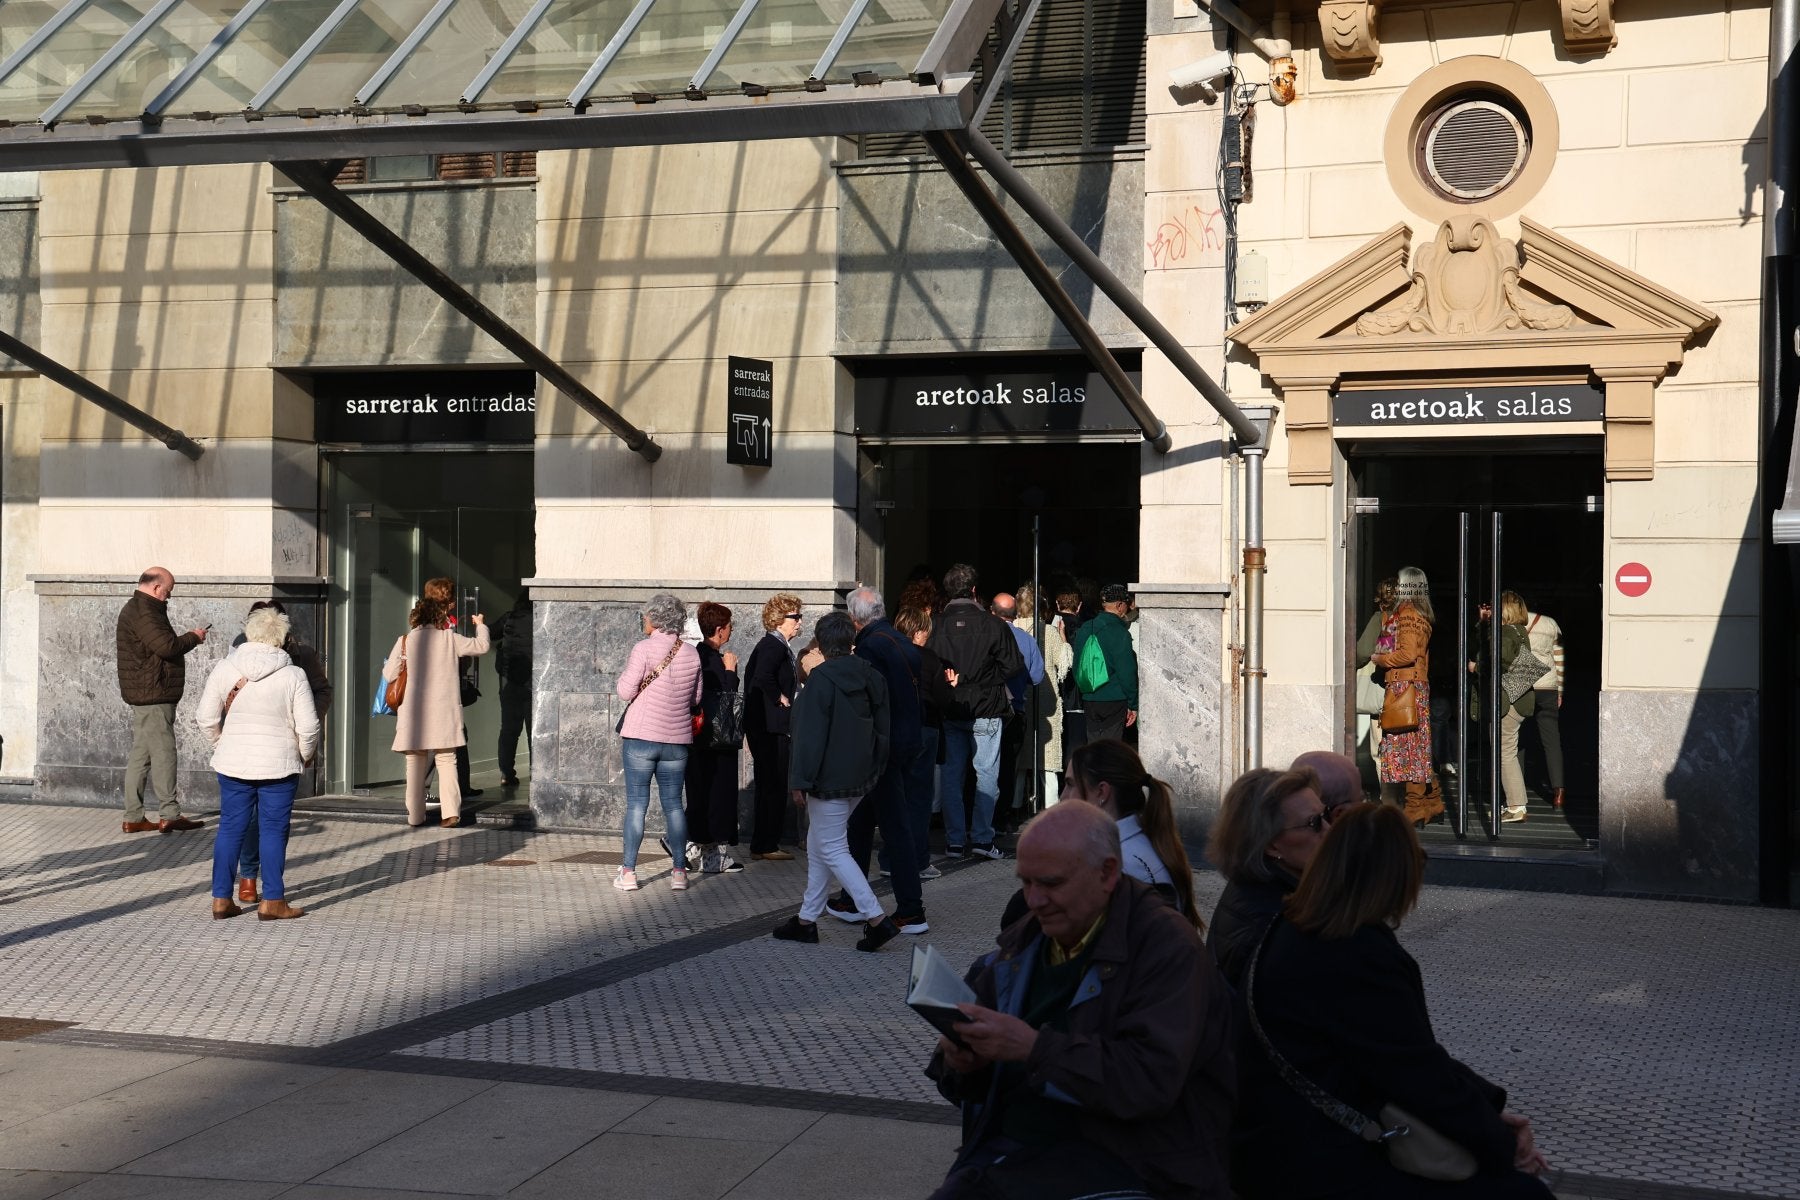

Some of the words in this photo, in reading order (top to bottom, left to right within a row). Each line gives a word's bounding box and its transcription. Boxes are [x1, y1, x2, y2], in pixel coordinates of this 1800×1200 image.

[733, 369, 771, 383] sarrerak
[346, 393, 439, 414] sarrerak
[446, 392, 536, 413] entradas
[734, 386, 770, 400] entradas
[916, 382, 1012, 406] aretoak
[1022, 381, 1086, 404] salas
[1370, 392, 1484, 420] aretoak
[1496, 391, 1572, 417] salas
